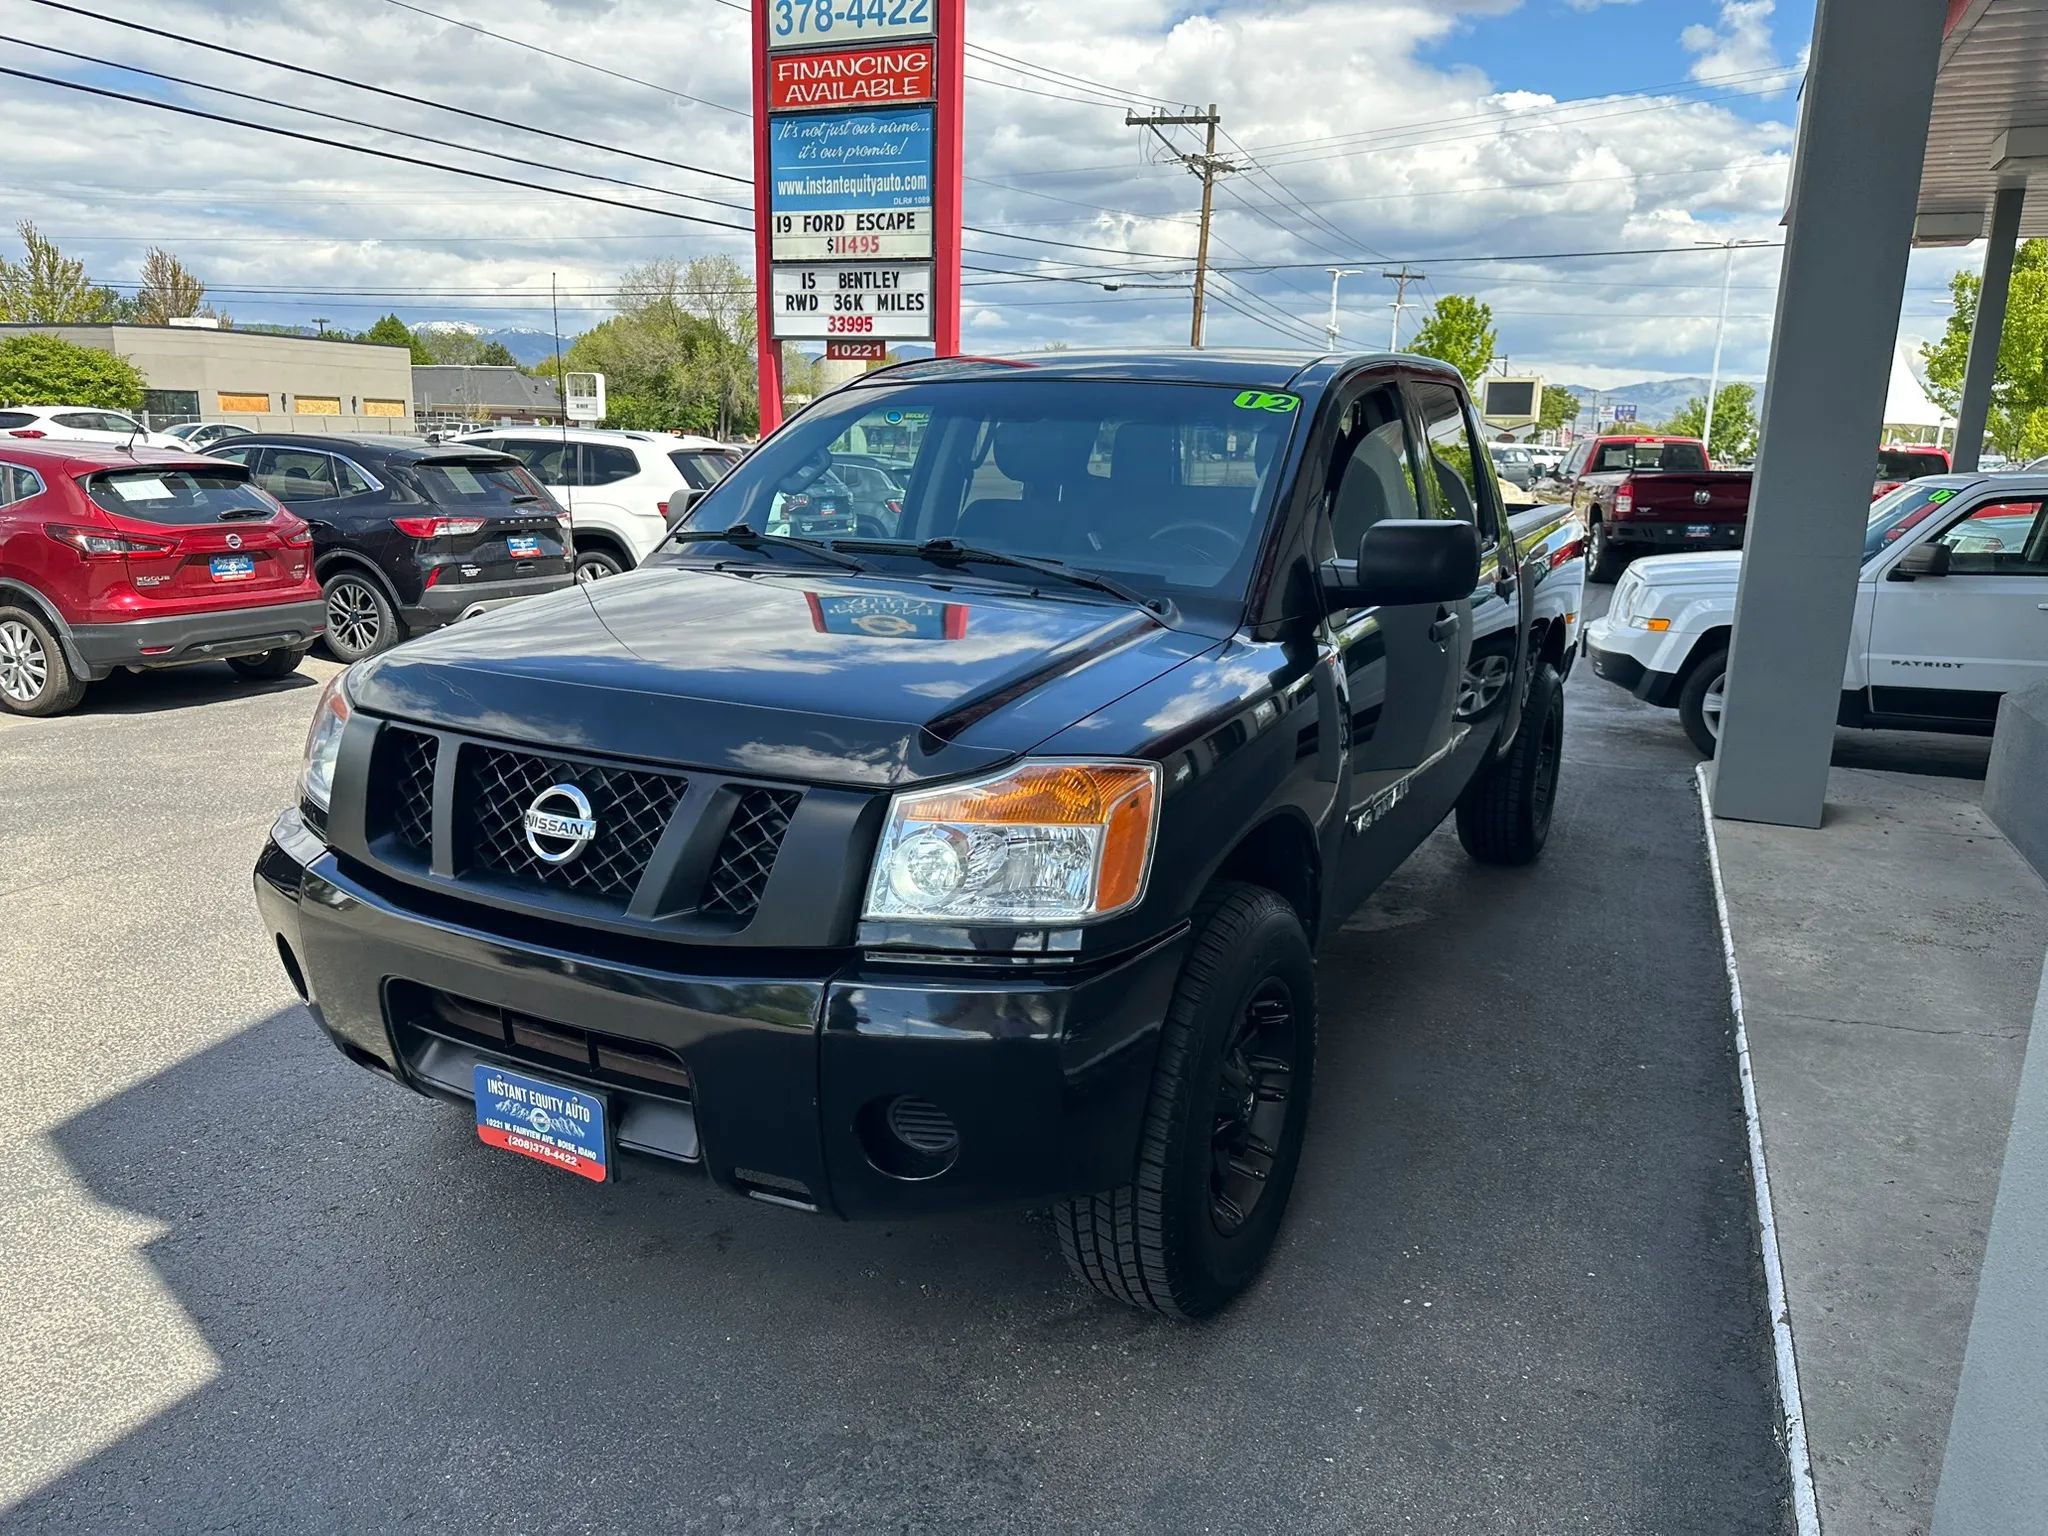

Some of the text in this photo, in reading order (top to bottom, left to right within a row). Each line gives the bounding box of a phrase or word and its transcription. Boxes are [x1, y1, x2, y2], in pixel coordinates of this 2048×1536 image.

[776, 0, 928, 35] 378-4422
[778, 53, 928, 81] FINANCING
[785, 77, 921, 103] AVAILABLE
[778, 121, 798, 140] It's
[801, 123, 829, 137] not
[819, 121, 850, 144] just
[852, 124, 879, 135] our
[798, 137, 908, 163] it's our promise!
[777, 173, 927, 197] www.instantequityauto.com
[776, 212, 916, 233] 19 FORD ESCAPE
[827, 234, 880, 254] $11495
[801, 271, 900, 290] 15 BENTLEY
[786, 293, 925, 312] RWD 36K MILES
[827, 315, 874, 333] 33995
[831, 343, 881, 358] 10221
[1243, 392, 1293, 411] 12
[1891, 660, 1965, 669] PATRIOT
[525, 814, 584, 836] NISSAN
[487, 1078, 591, 1123] INSTANT EQUITY AUTO
[485, 1117, 504, 1129] 10221
[512, 1125, 541, 1141] FAIRVIEW
[557, 1139, 578, 1154] BOISE,
[577, 1146, 597, 1160] IDAHO
[507, 1134, 578, 1166] (208)378-4422
